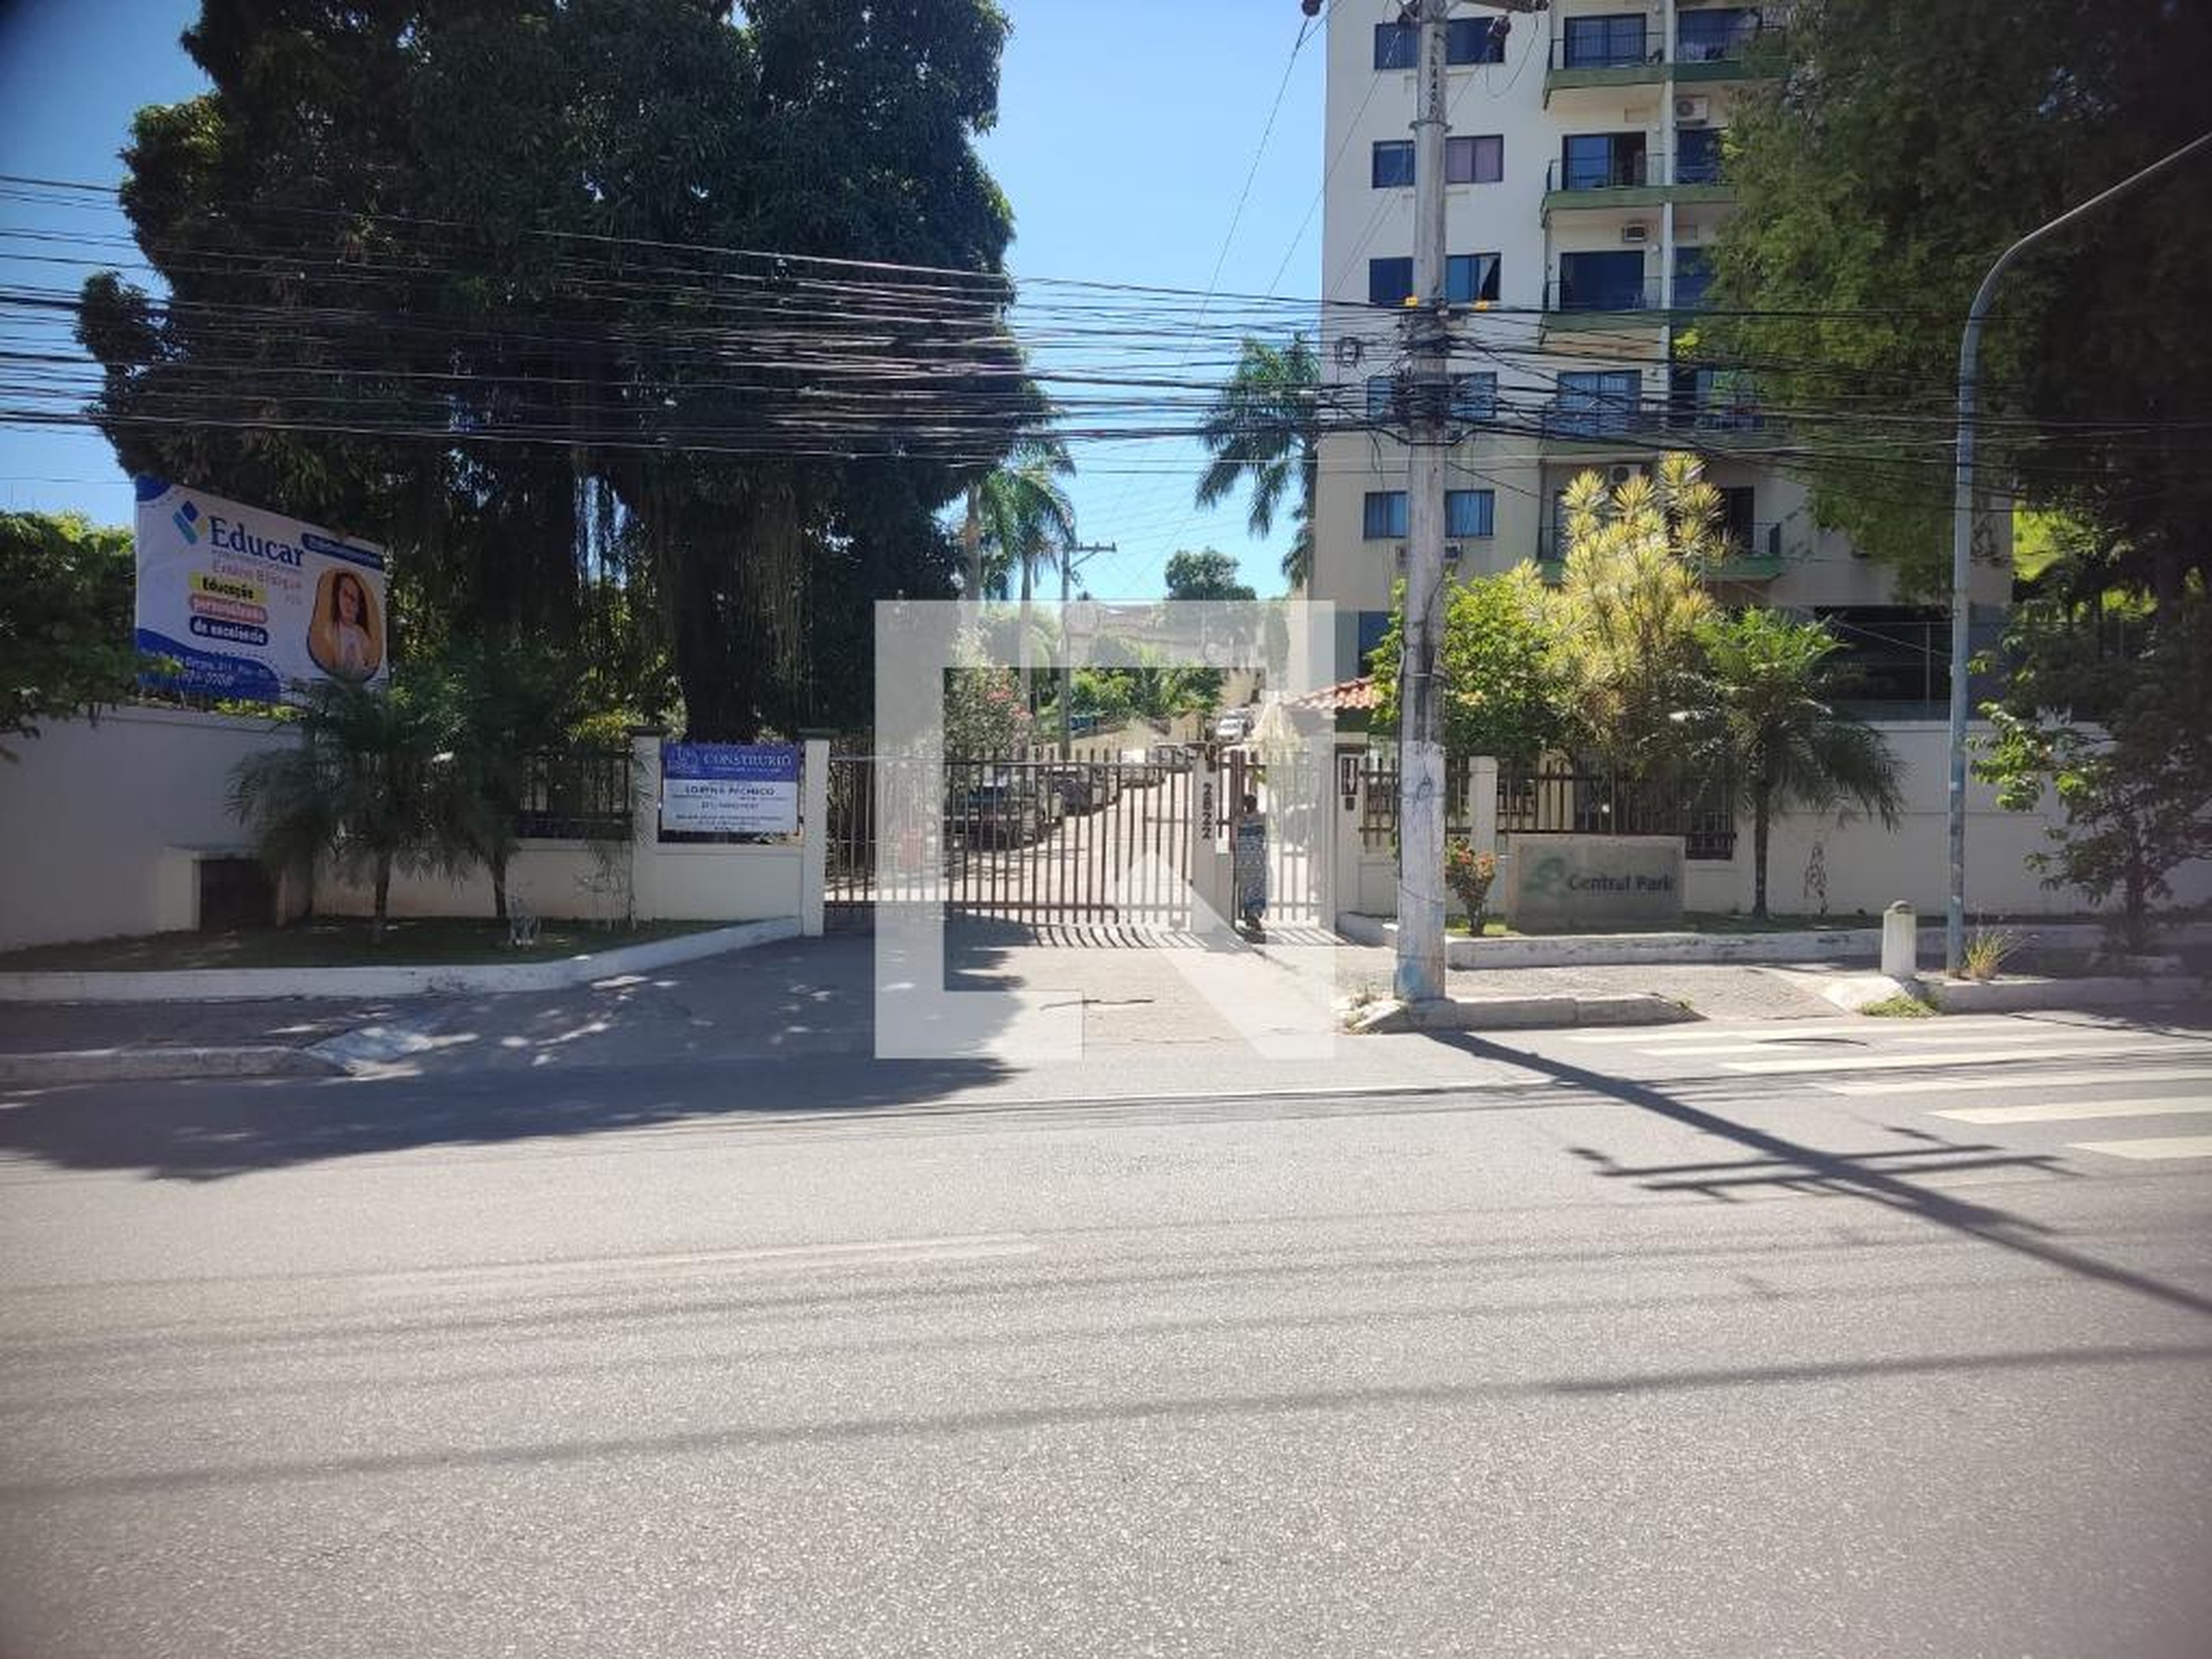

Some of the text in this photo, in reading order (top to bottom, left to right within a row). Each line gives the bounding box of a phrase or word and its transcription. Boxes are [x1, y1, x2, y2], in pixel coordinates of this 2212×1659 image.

[209, 516, 304, 567] Educar
[202, 576, 254, 600] Educação
[194, 618, 208, 634] de
[1201, 782, 1213, 841] 2822
[1569, 874, 1672, 891] Central Park
